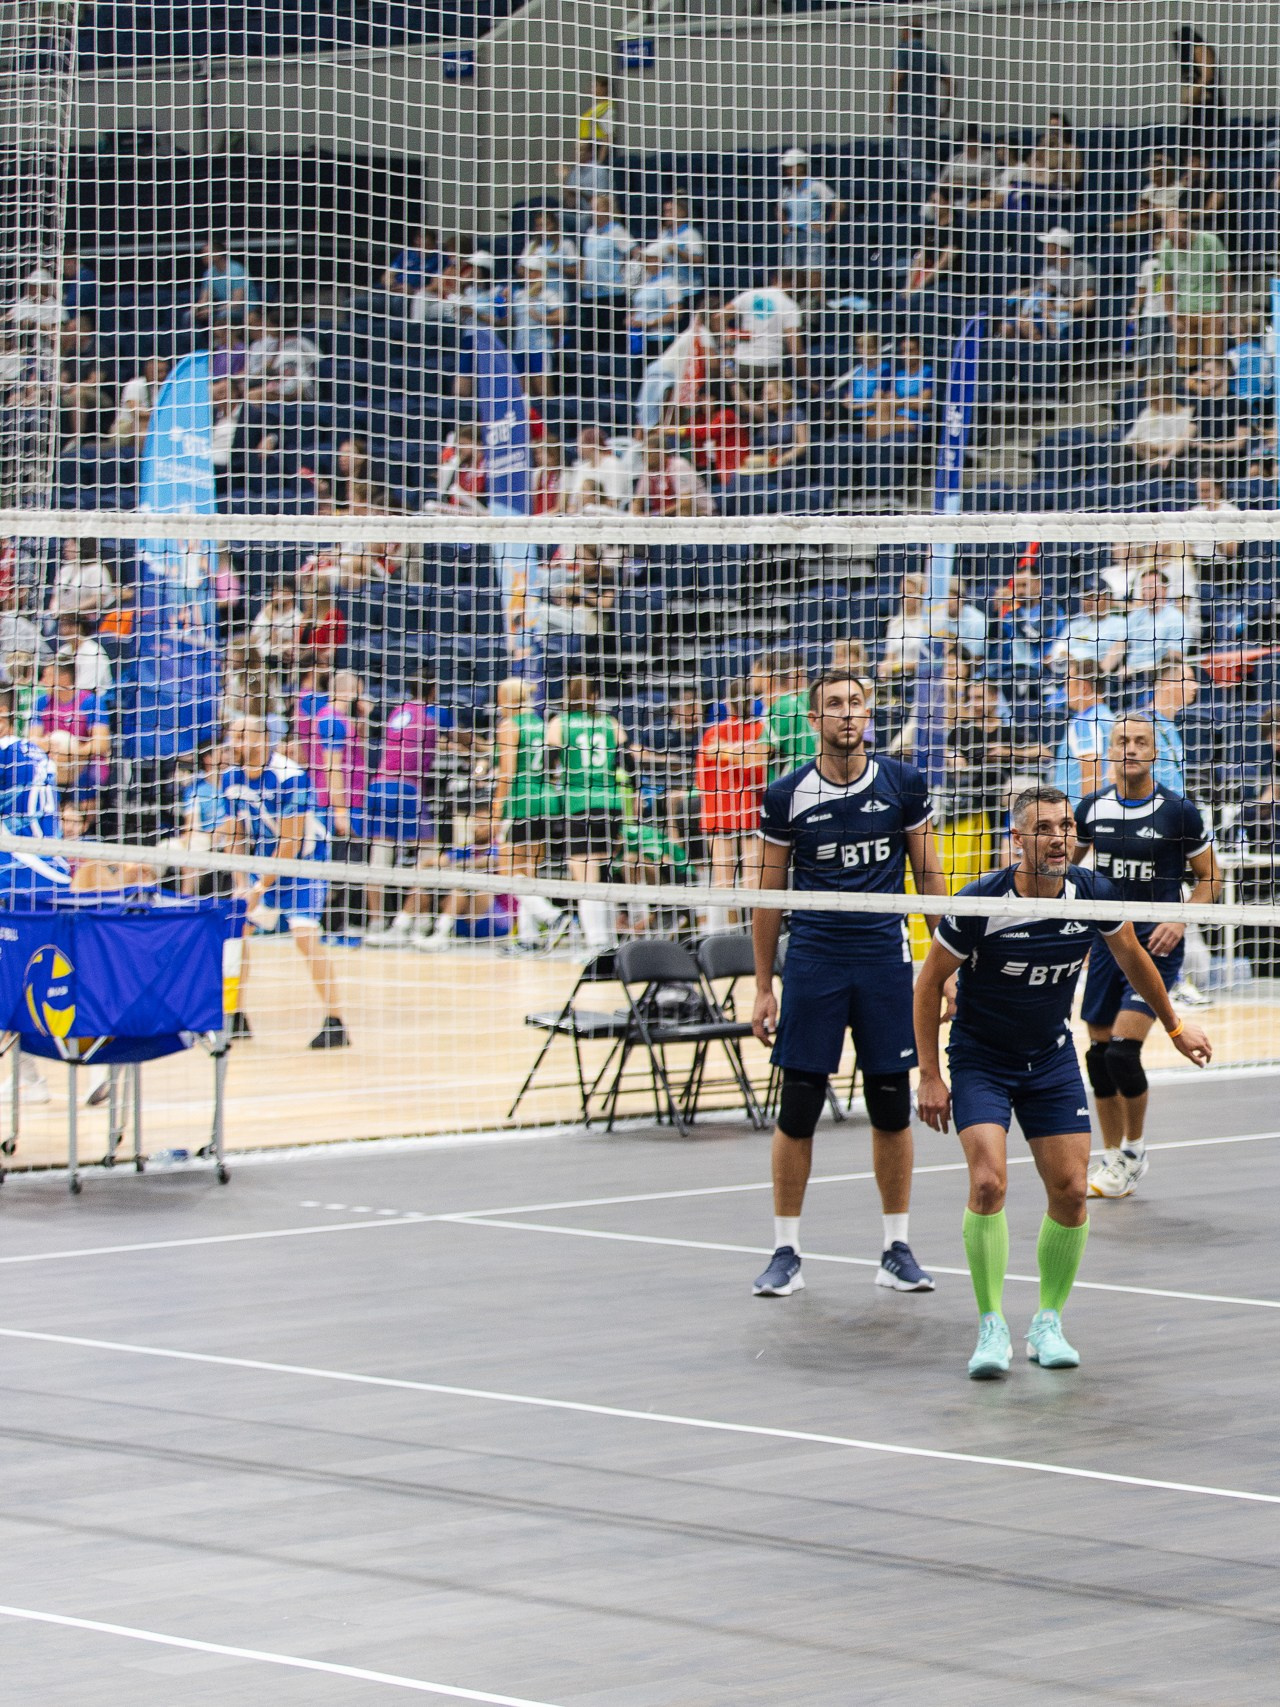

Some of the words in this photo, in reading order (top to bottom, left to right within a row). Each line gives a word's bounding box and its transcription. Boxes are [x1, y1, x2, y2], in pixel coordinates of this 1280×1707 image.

[576, 732, 606, 768] 13
[840, 837, 891, 868] ВТБ
[1112, 858, 1155, 882] ВТБ
